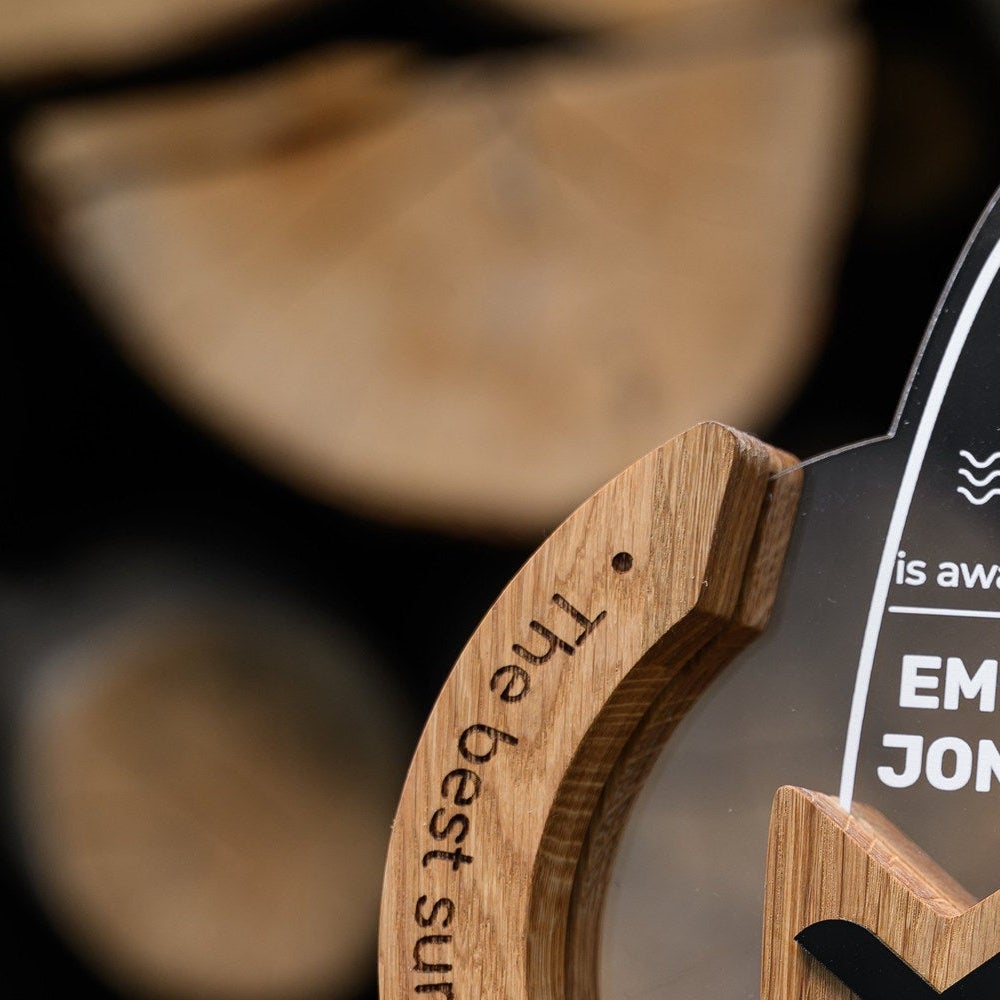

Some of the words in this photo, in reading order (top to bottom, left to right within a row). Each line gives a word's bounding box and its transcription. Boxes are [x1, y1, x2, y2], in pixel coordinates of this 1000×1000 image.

[895, 550, 927, 586] is
[490, 593, 608, 703] The
[422, 723, 519, 871] best
